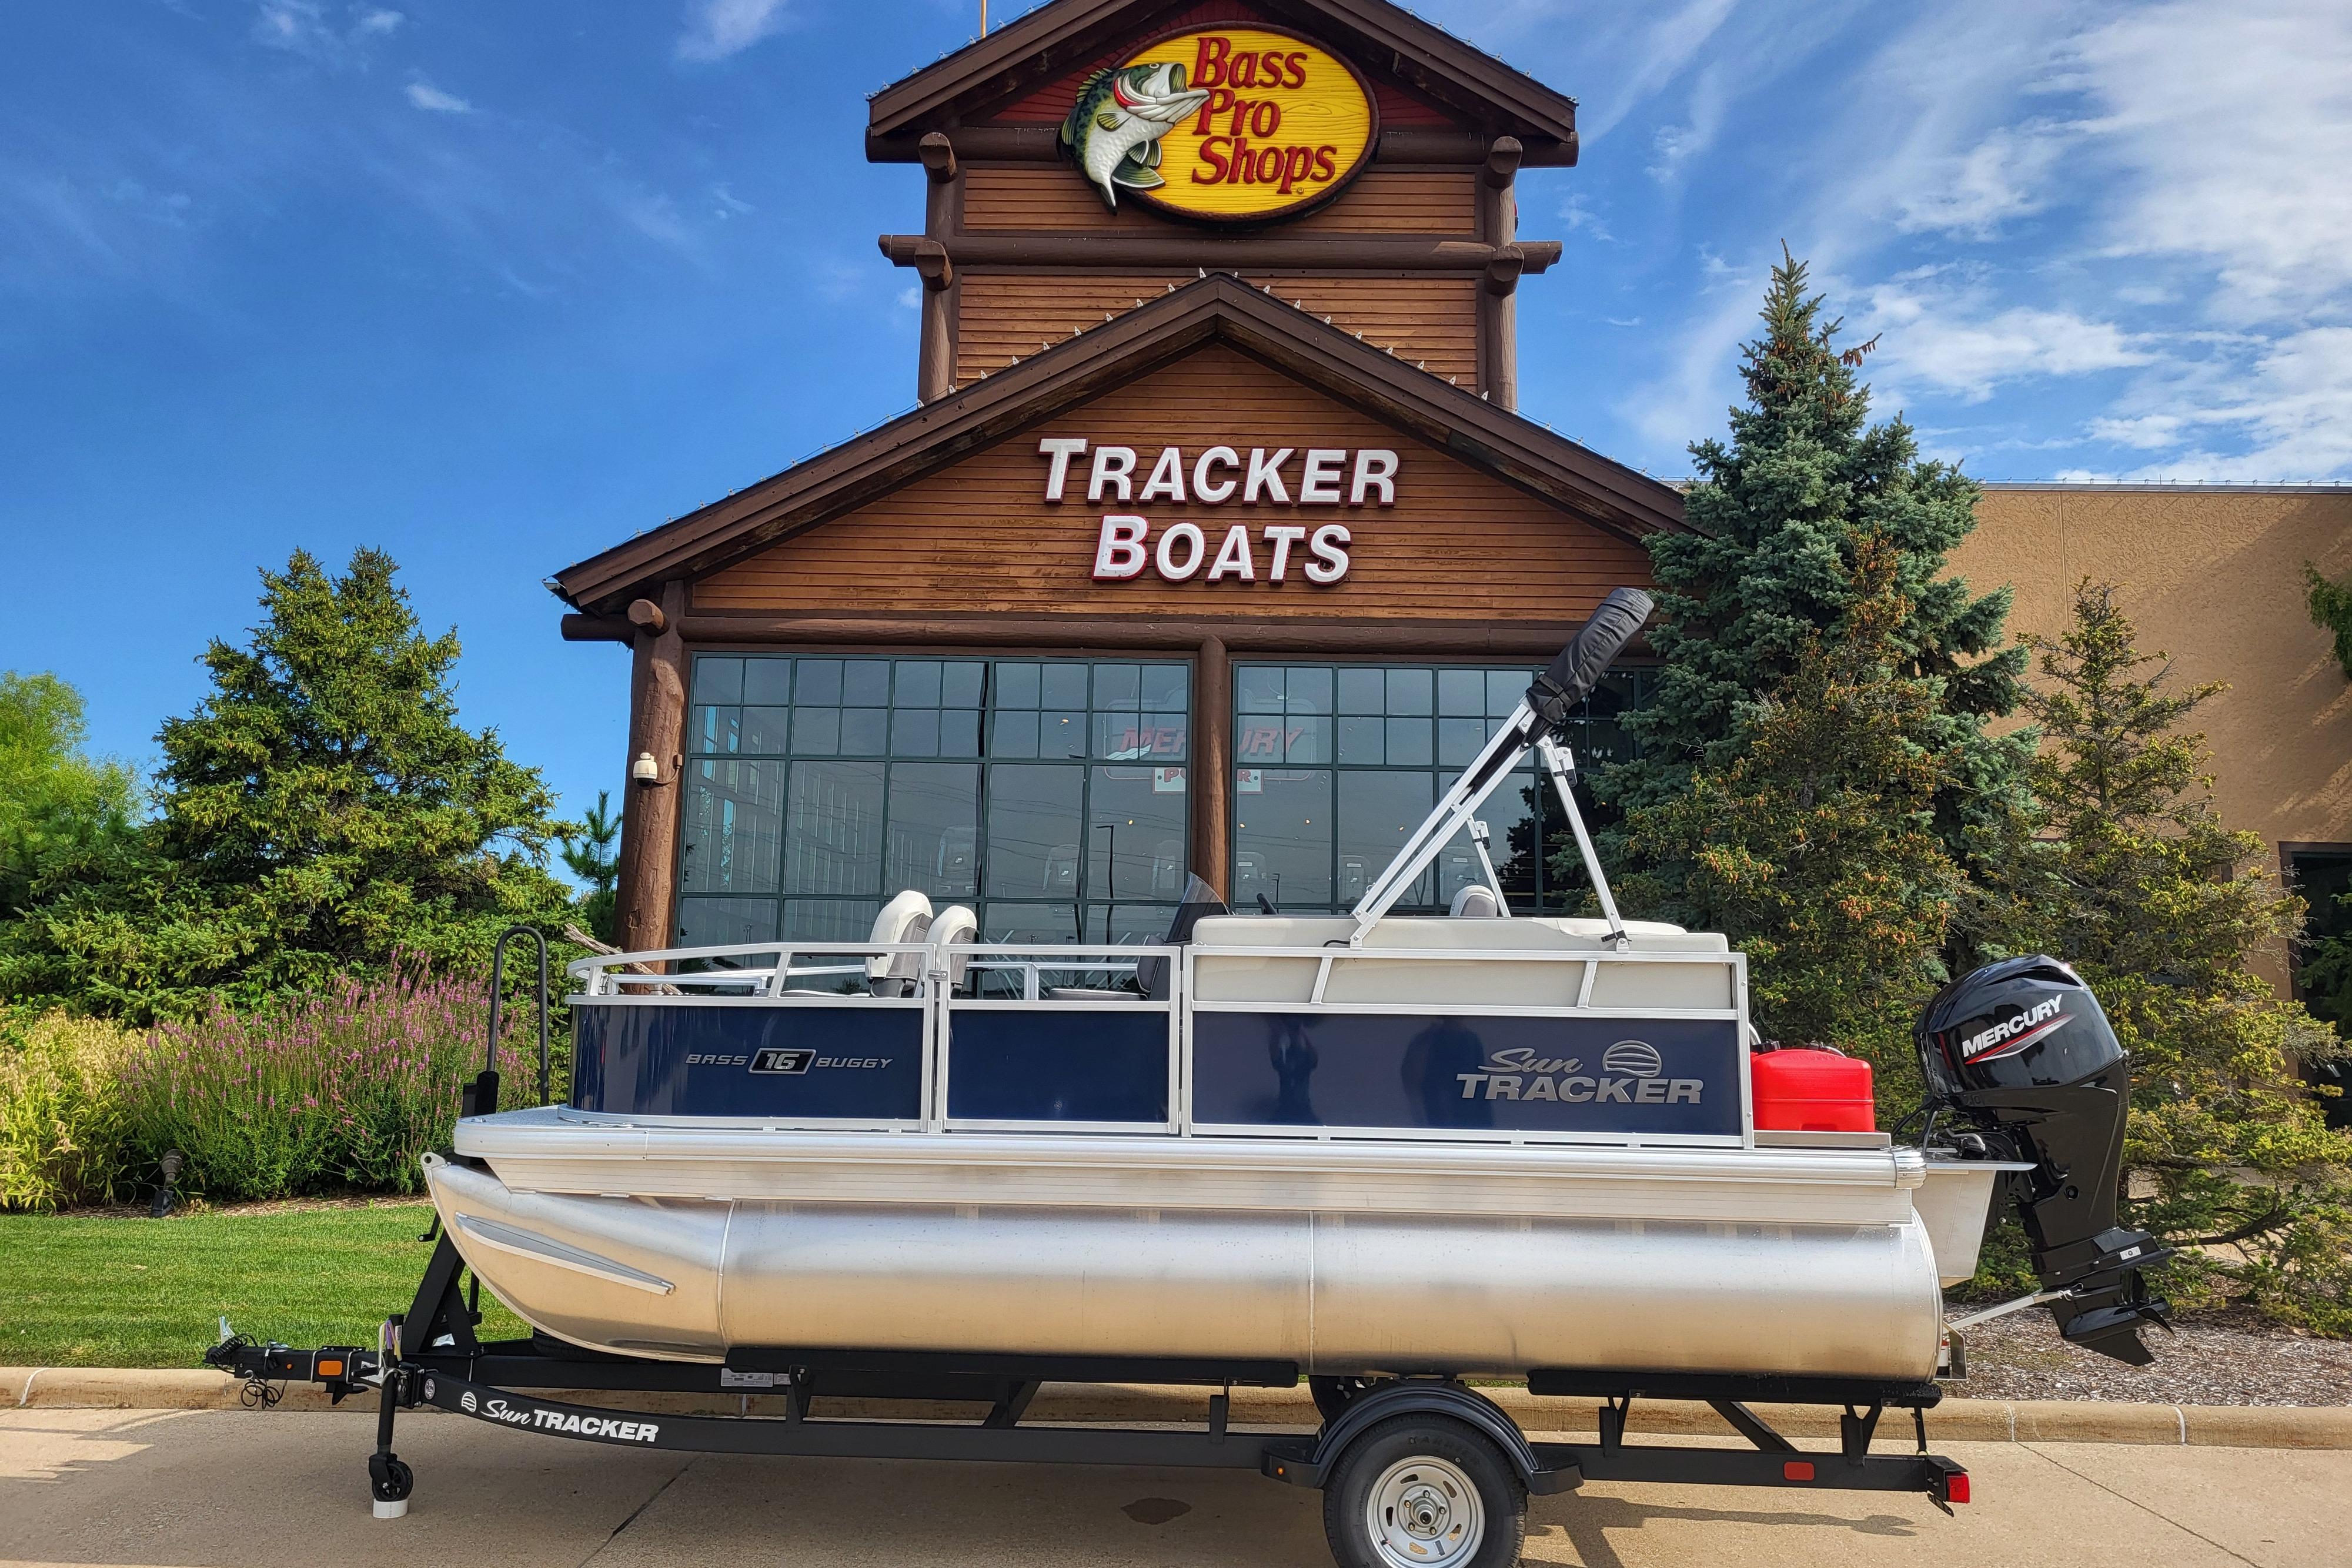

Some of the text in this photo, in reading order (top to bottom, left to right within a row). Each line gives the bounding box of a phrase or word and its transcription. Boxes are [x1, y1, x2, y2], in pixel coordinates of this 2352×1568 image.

[1188, 36, 1308, 89] Bass
[1192, 89, 1281, 138] Pro
[1192, 136, 1338, 195] Shops
[1038, 437, 1400, 508] TRACKER
[1091, 513, 1352, 586] BOATS
[1962, 994, 2063, 1058] MERCURY
[685, 1052, 894, 1070] BASS 16 BUGGY
[1477, 1048, 1583, 1074] Sun
[1456, 1074, 1704, 1104] TRACKER
[480, 1399, 659, 1442] Sun TRACKER
